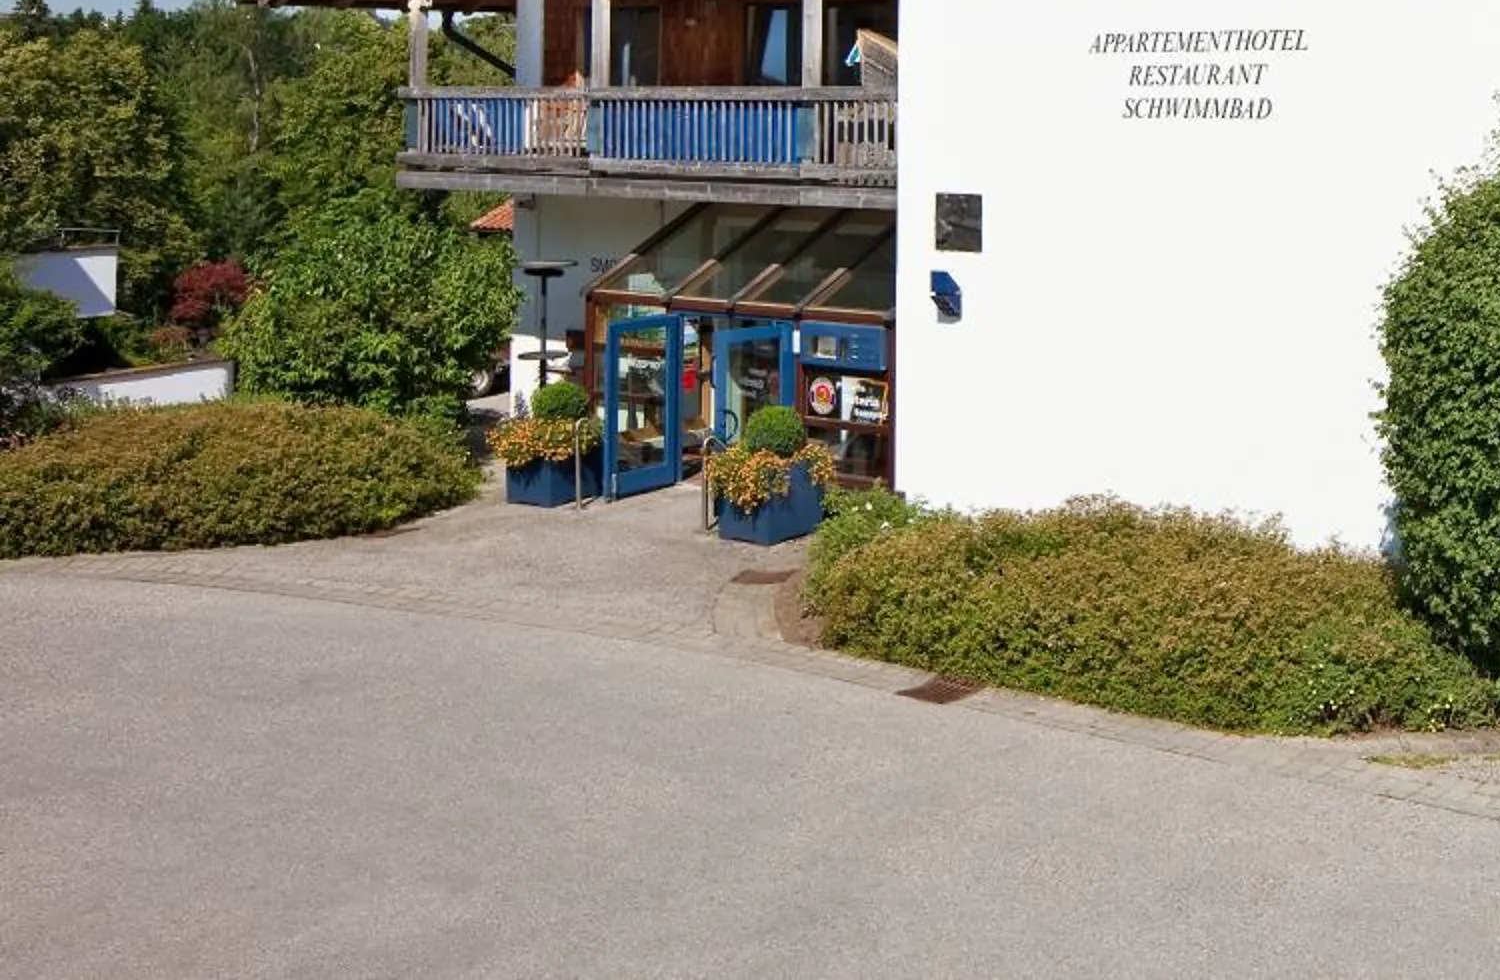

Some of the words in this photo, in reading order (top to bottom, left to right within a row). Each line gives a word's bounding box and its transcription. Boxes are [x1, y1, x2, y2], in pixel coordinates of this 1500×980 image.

[1089, 29, 1309, 54] APPARTEMENTHOTEL
[1128, 63, 1269, 87] RESTAURANT
[1122, 97, 1273, 120] SCHWIMMBAD
